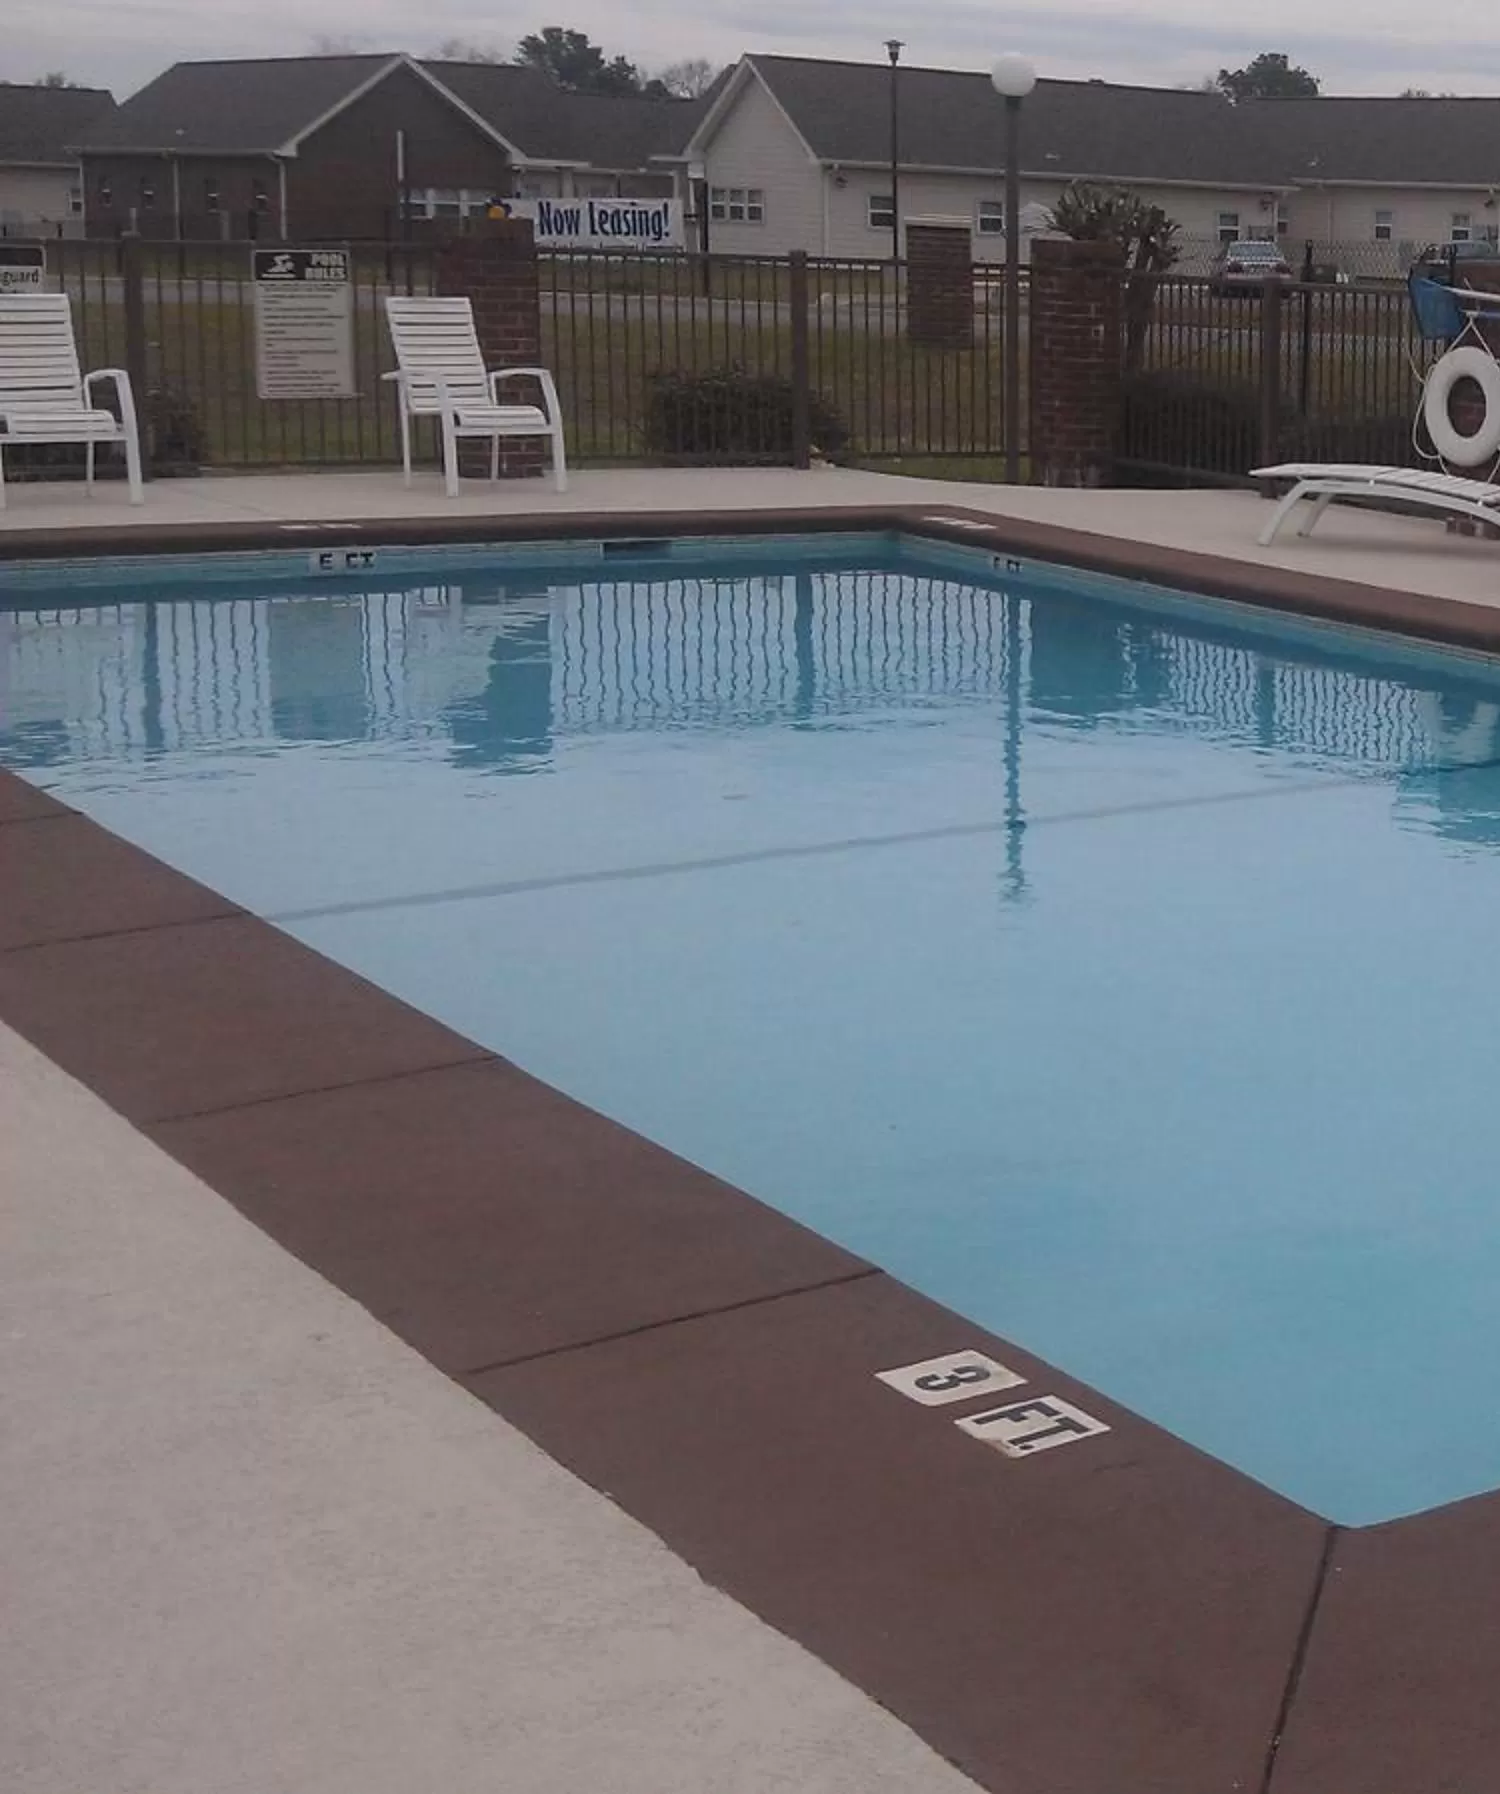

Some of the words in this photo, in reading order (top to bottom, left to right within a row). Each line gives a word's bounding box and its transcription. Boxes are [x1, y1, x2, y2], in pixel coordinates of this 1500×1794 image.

[538, 201, 580, 236] Now
[588, 201, 669, 241] Leasing!
[310, 252, 345, 266] POOL
[914, 1365, 990, 1390] 3
